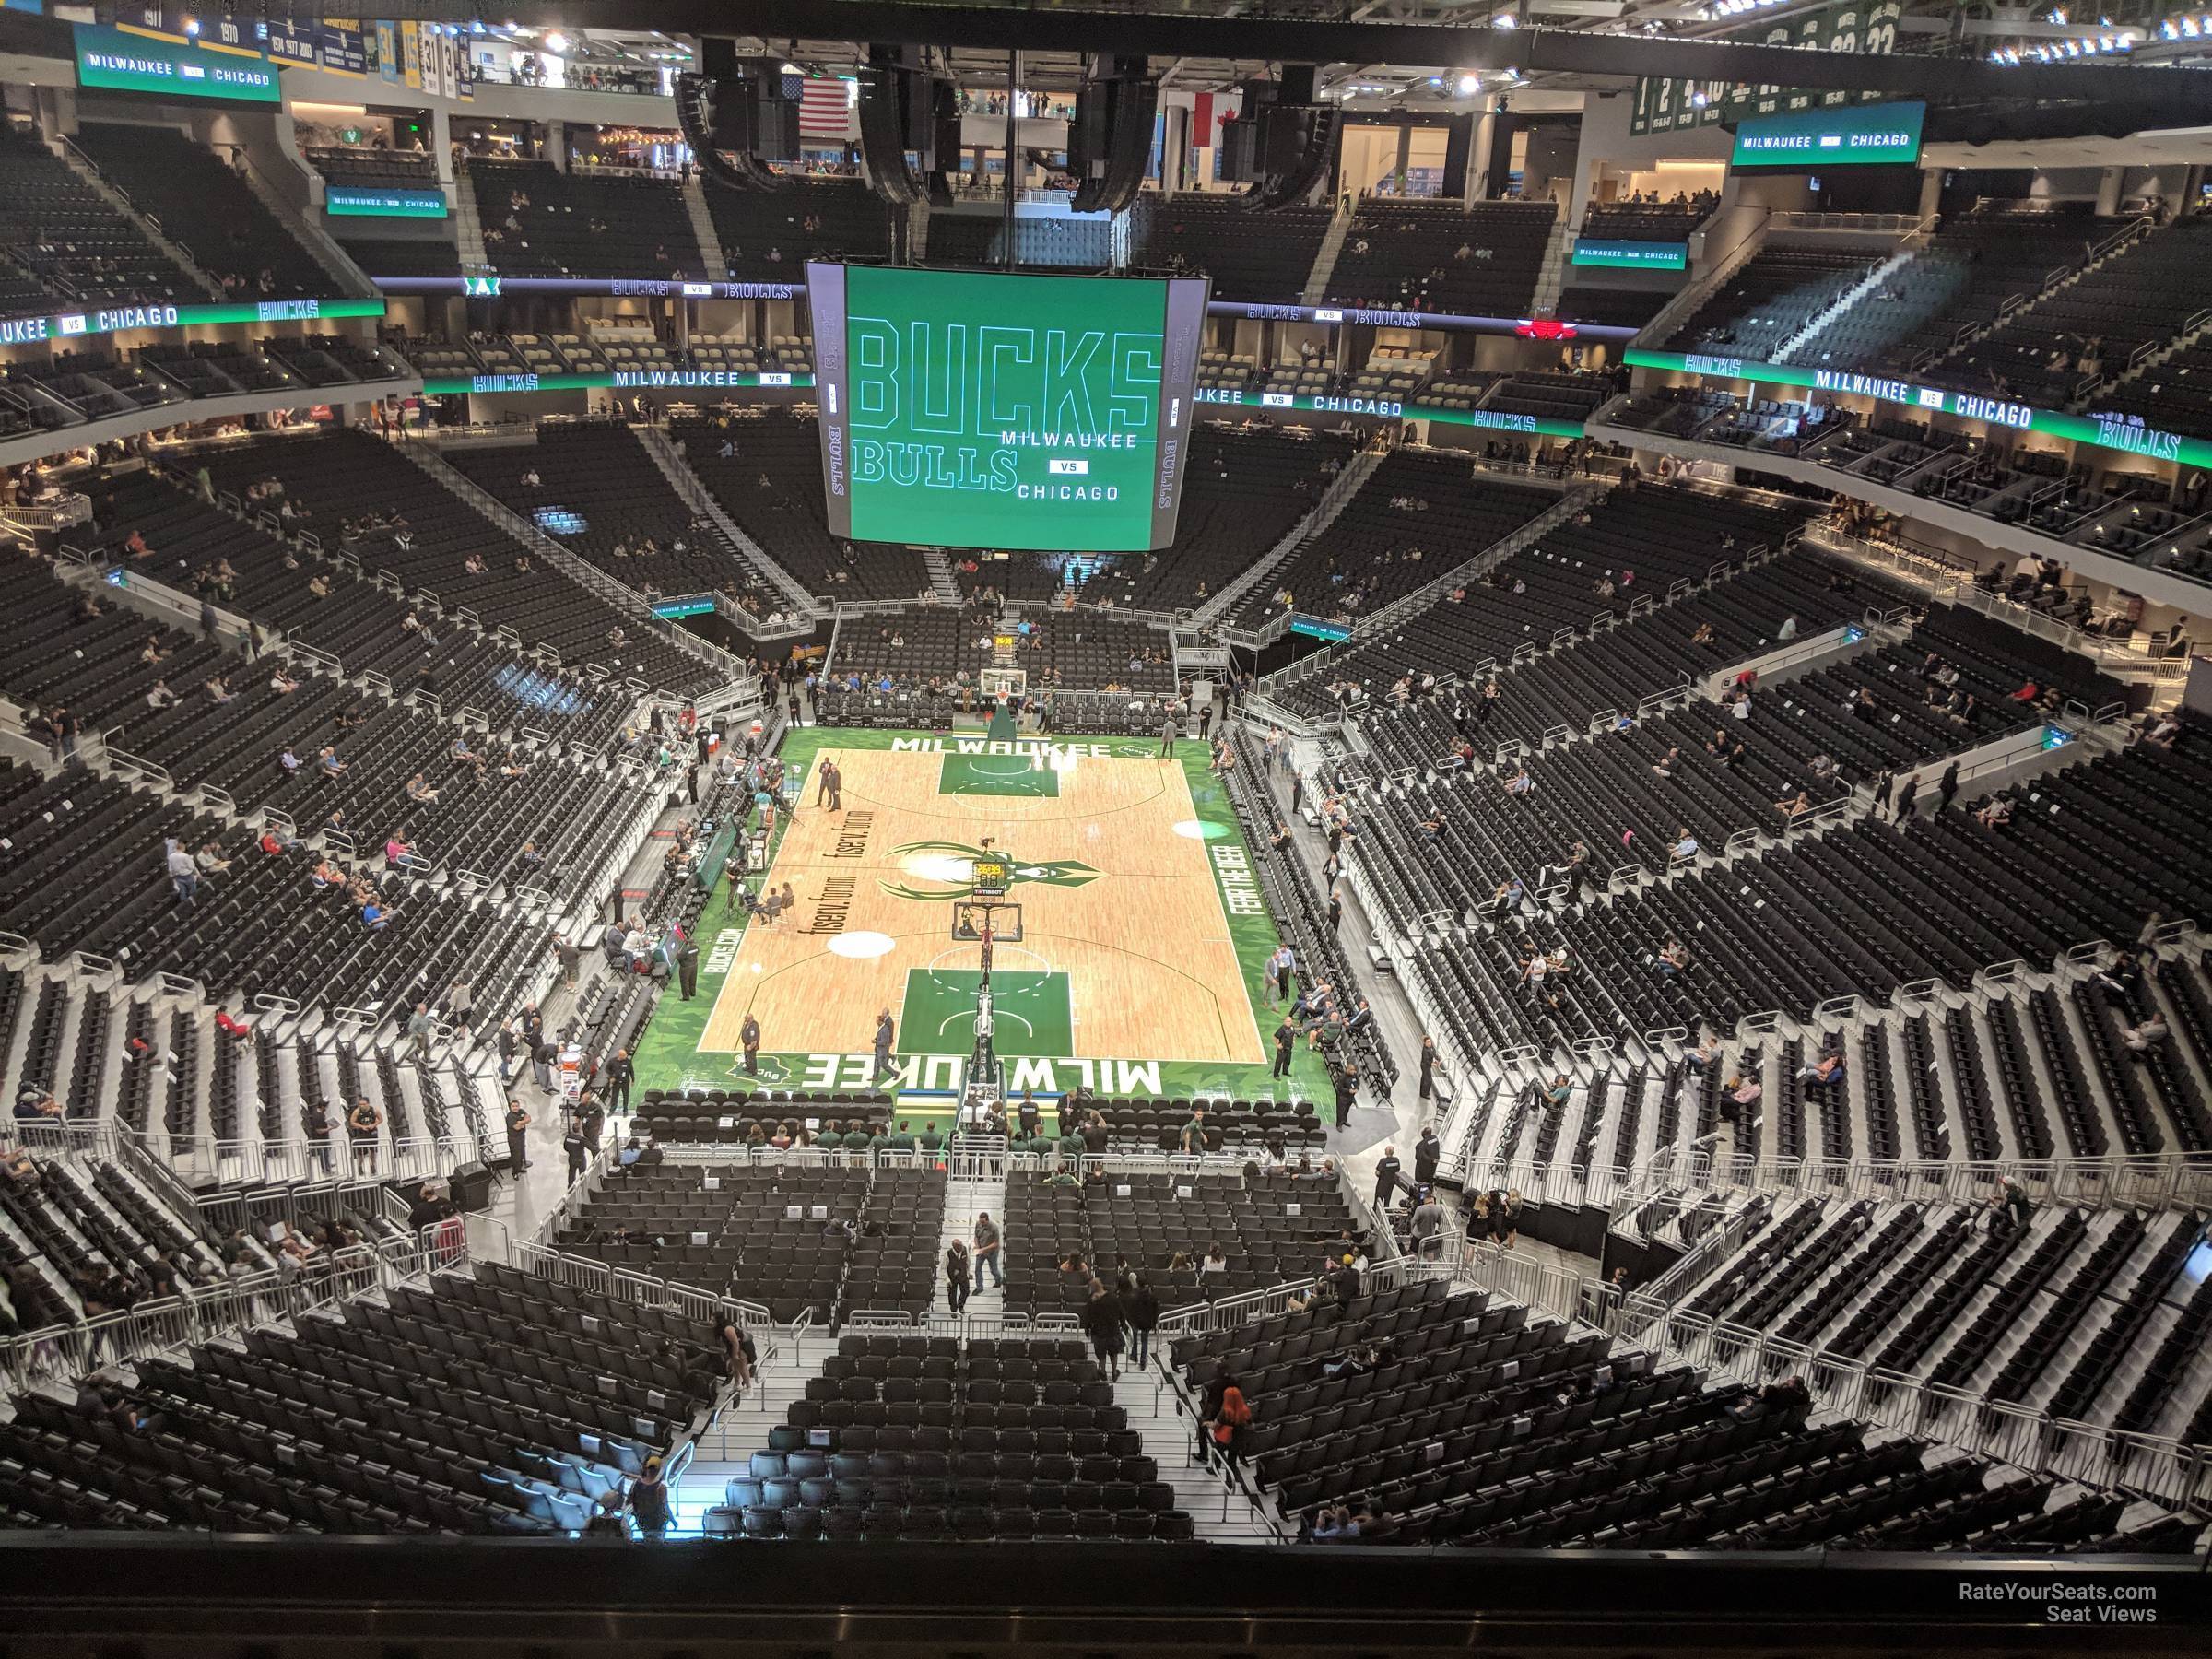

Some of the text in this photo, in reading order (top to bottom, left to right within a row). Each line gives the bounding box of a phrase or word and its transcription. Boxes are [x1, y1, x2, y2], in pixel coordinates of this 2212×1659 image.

[89, 54, 173, 76] MILWAUKEE
[215, 69, 270, 86] CHICAGO
[424, 40, 437, 75] 31
[1638, 76, 1648, 116] 1
[1658, 78, 1672, 112] 2
[1743, 136, 1812, 148] MILWAUKEE
[1850, 135, 1909, 147] CHICAGO
[334, 197, 382, 206] MILWAUKEE
[1579, 249, 1622, 257] MILWAUKEE
[612, 278, 670, 296] BUCKS
[100, 307, 178, 331] CHICAGO
[258, 299, 319, 322] BUCKS
[1247, 303, 1302, 321] BUCKS
[473, 373, 538, 393] BUCKS
[616, 371, 739, 386] MILWAUKEE
[847, 316, 1166, 443] BUCKS
[1684, 354, 1742, 378] BUCKS
[1816, 370, 1909, 402] MILWAUKEE
[1955, 394, 2032, 428] CHICAGO
[1314, 395, 1402, 417] CHICAGO
[1474, 409, 1536, 432] BUCKS
[1001, 429, 1137, 449] MILWAUKEE
[2096, 420, 2182, 460] BULLS
[829, 425, 844, 497] BULLS
[852, 439, 1018, 492] BULLS
[1159, 440, 1178, 509] BULLS
[1018, 484, 1119, 501] CHICAGO
[891, 737, 1112, 758] MILWAUKEE
[822, 811, 875, 859] fiserv.forum
[1218, 869, 1255, 888] THE
[796, 876, 858, 935] fiserv.forum
[1224, 888, 1265, 915] FEAR
[801, 1053, 1163, 1094] MILWUKEE
